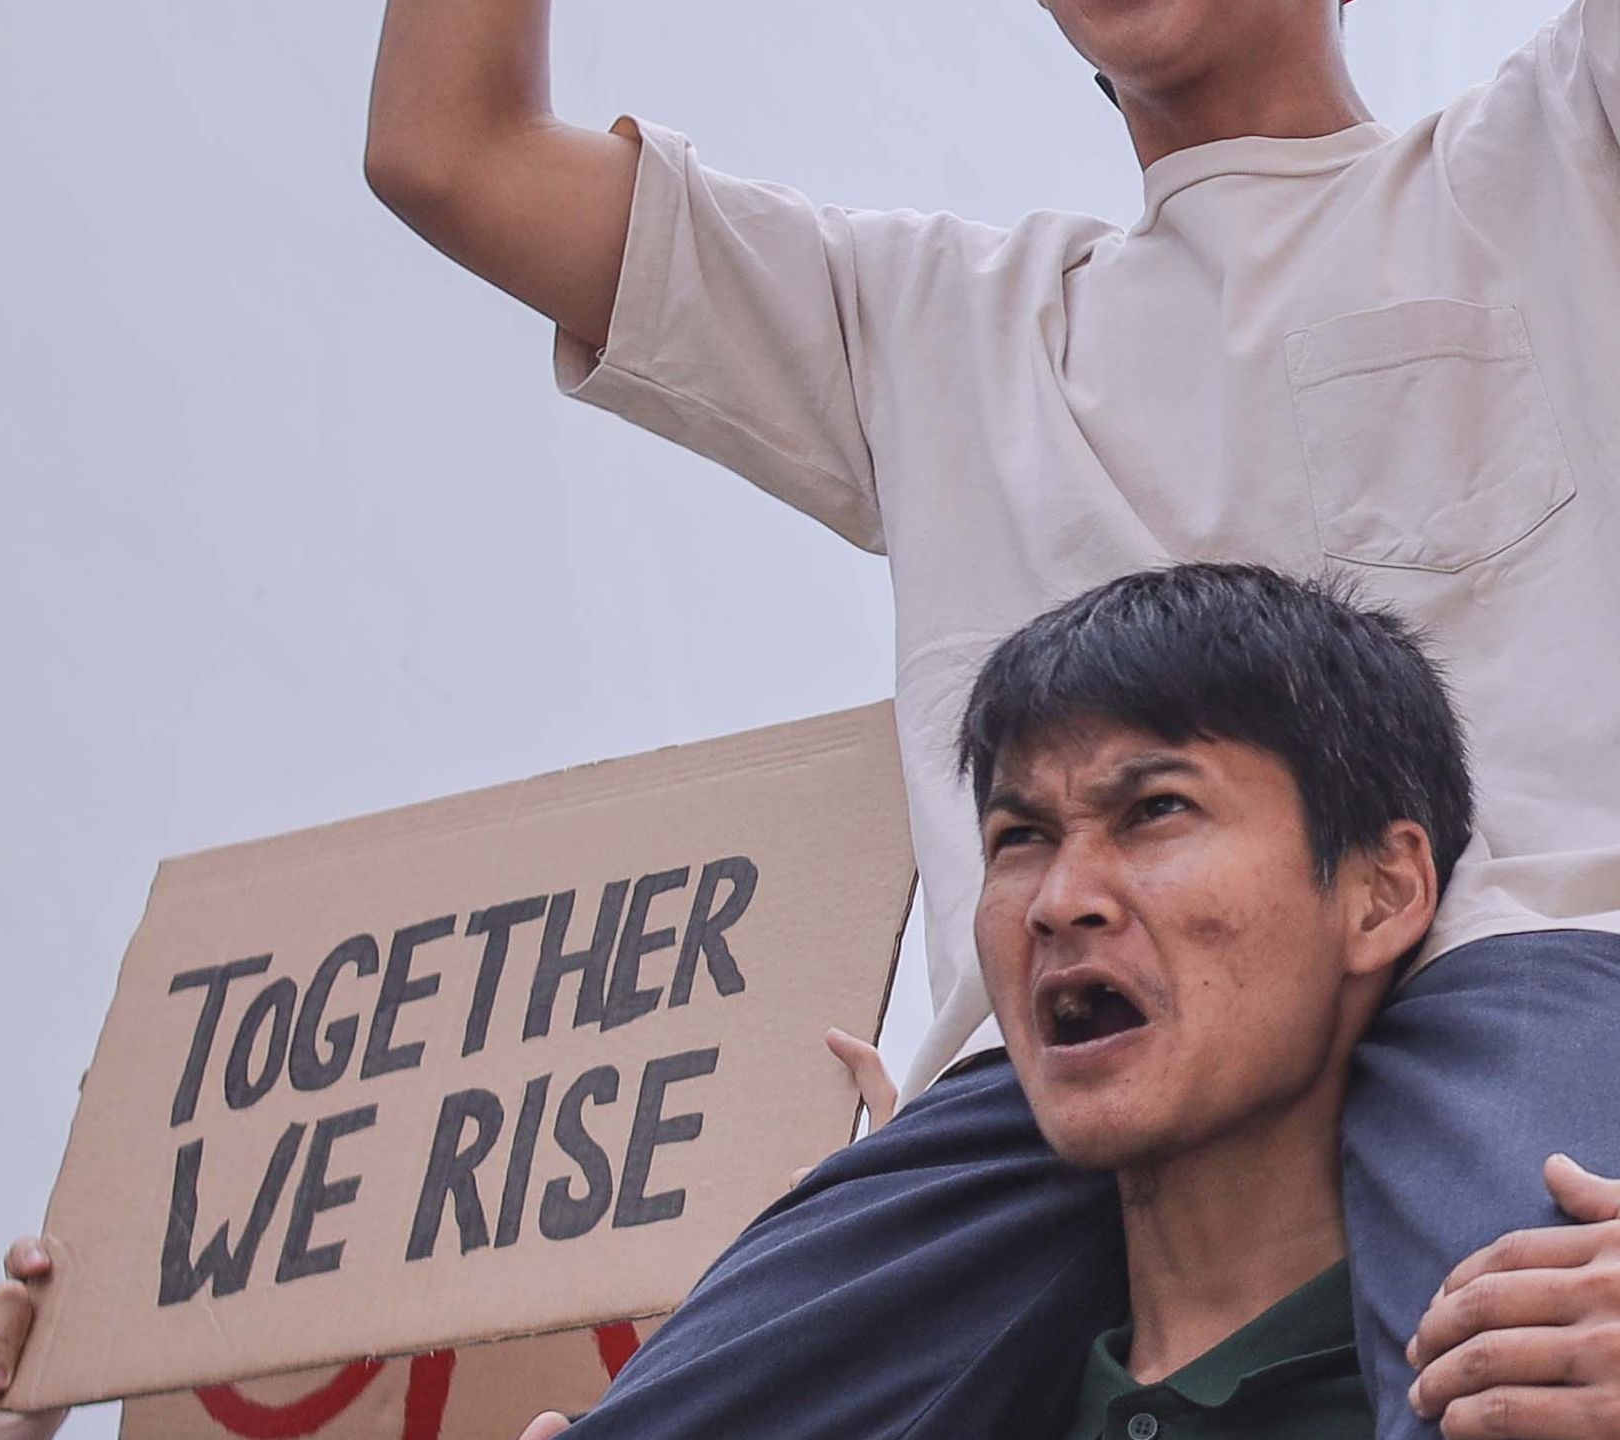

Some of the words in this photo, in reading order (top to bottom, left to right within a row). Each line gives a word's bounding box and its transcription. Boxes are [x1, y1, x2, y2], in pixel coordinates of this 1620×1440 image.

[168, 855, 759, 1127] TOGETHER
[158, 1105, 377, 1307] WE
[405, 1047, 719, 1262] RISE
